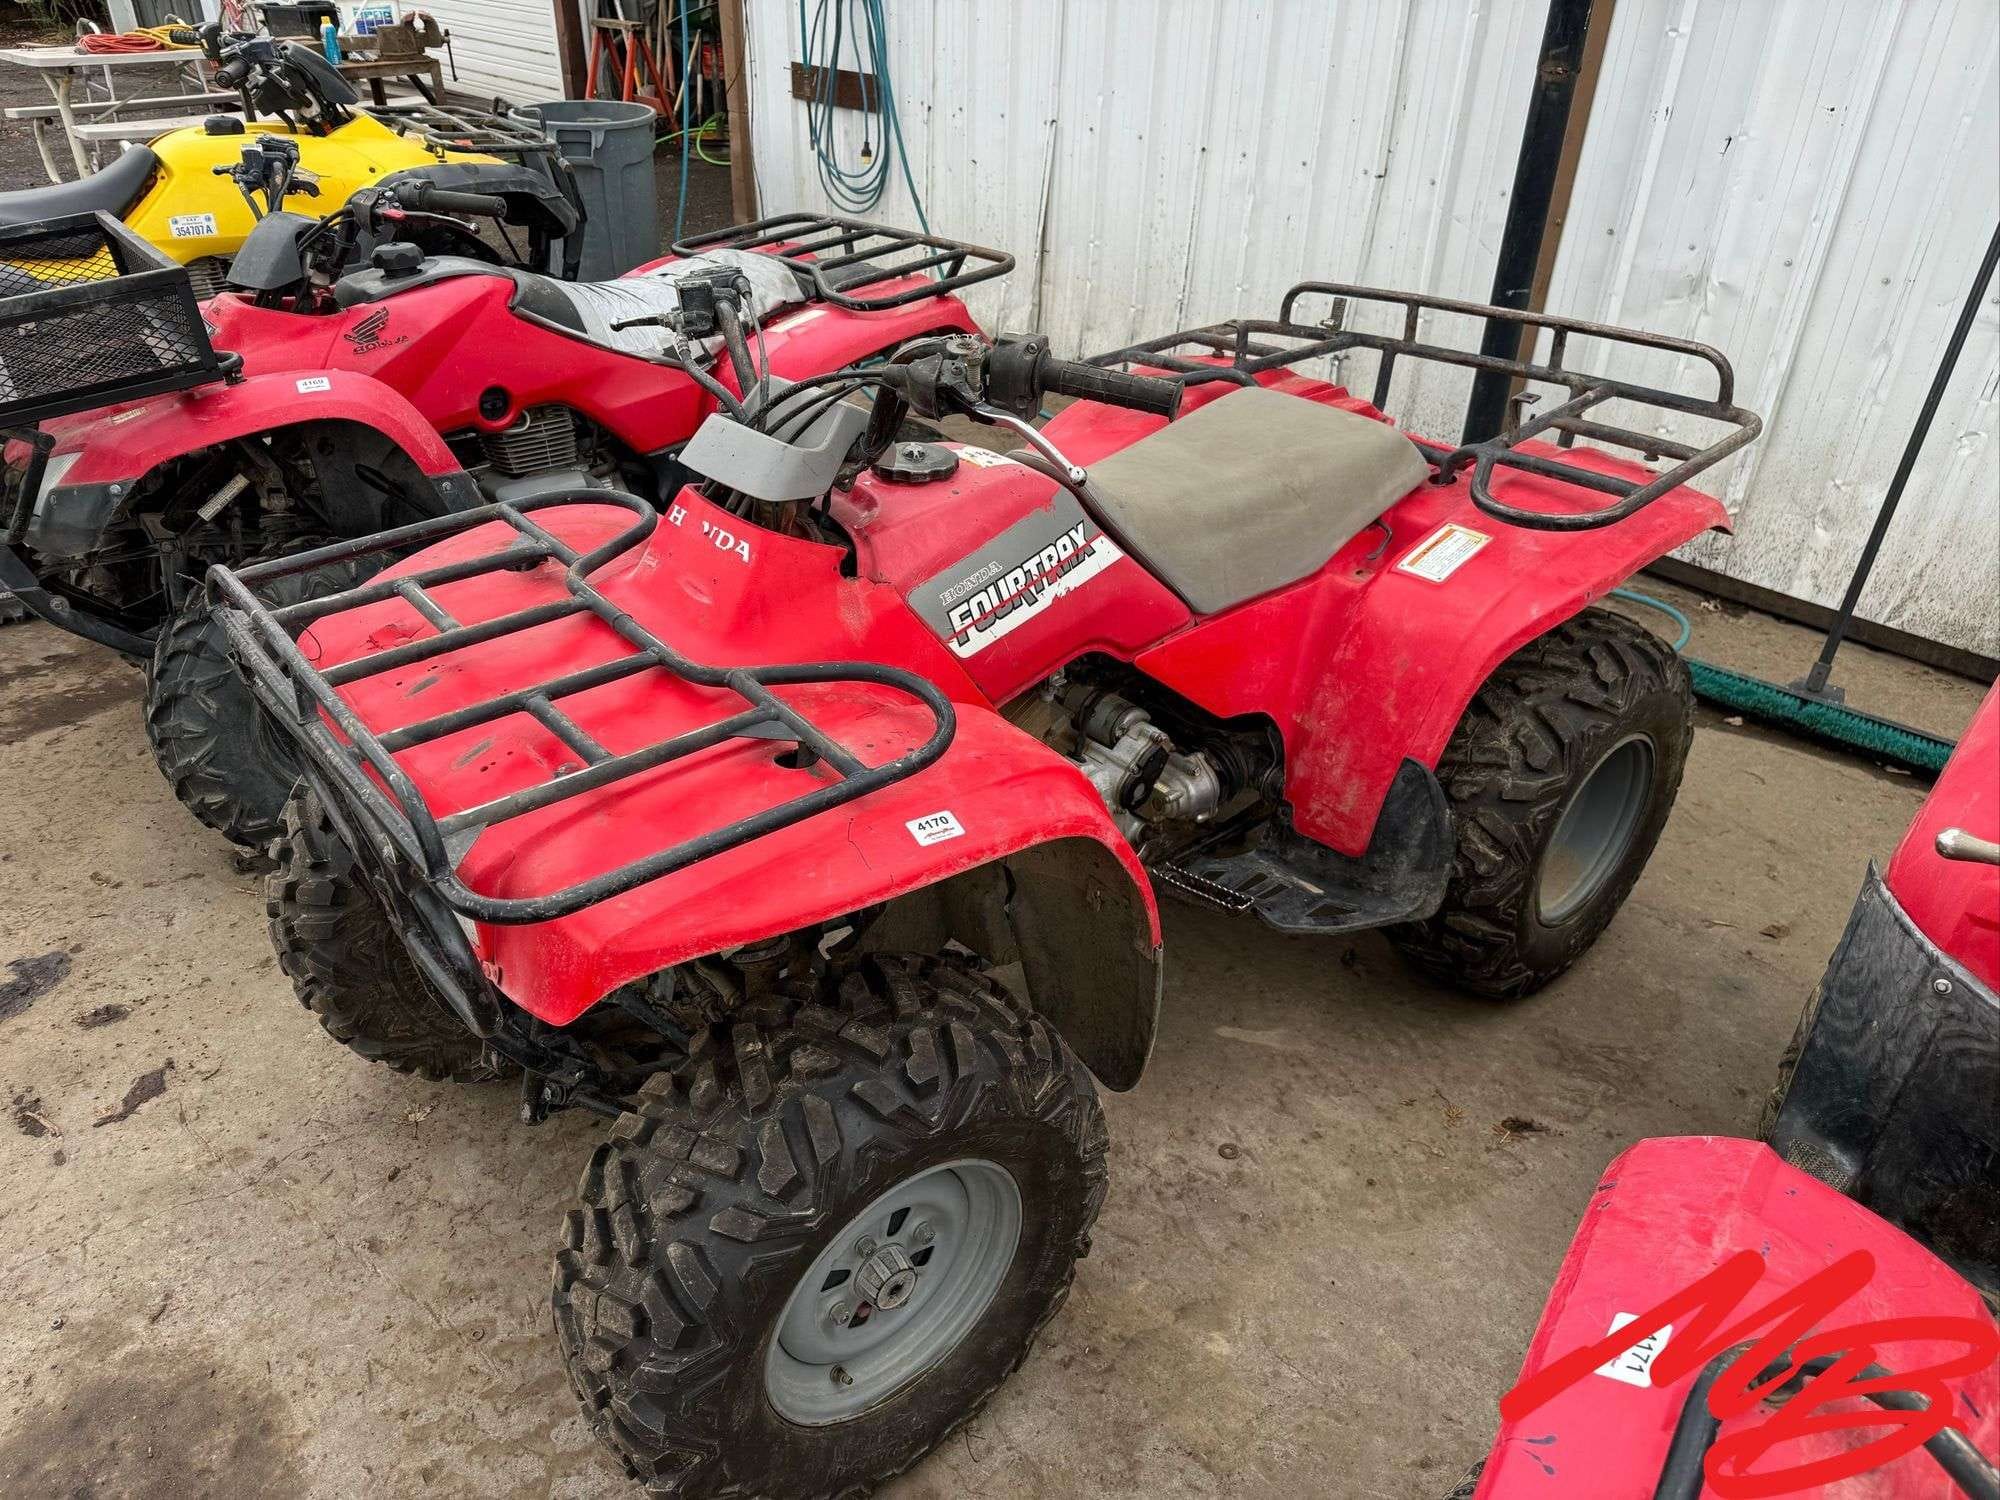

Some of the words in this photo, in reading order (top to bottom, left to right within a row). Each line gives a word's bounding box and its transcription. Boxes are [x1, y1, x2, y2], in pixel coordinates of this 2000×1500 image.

[940, 560, 1003, 605] HONDA
[947, 520, 1096, 647] FOURTRAX
[917, 816, 949, 831] 4170
